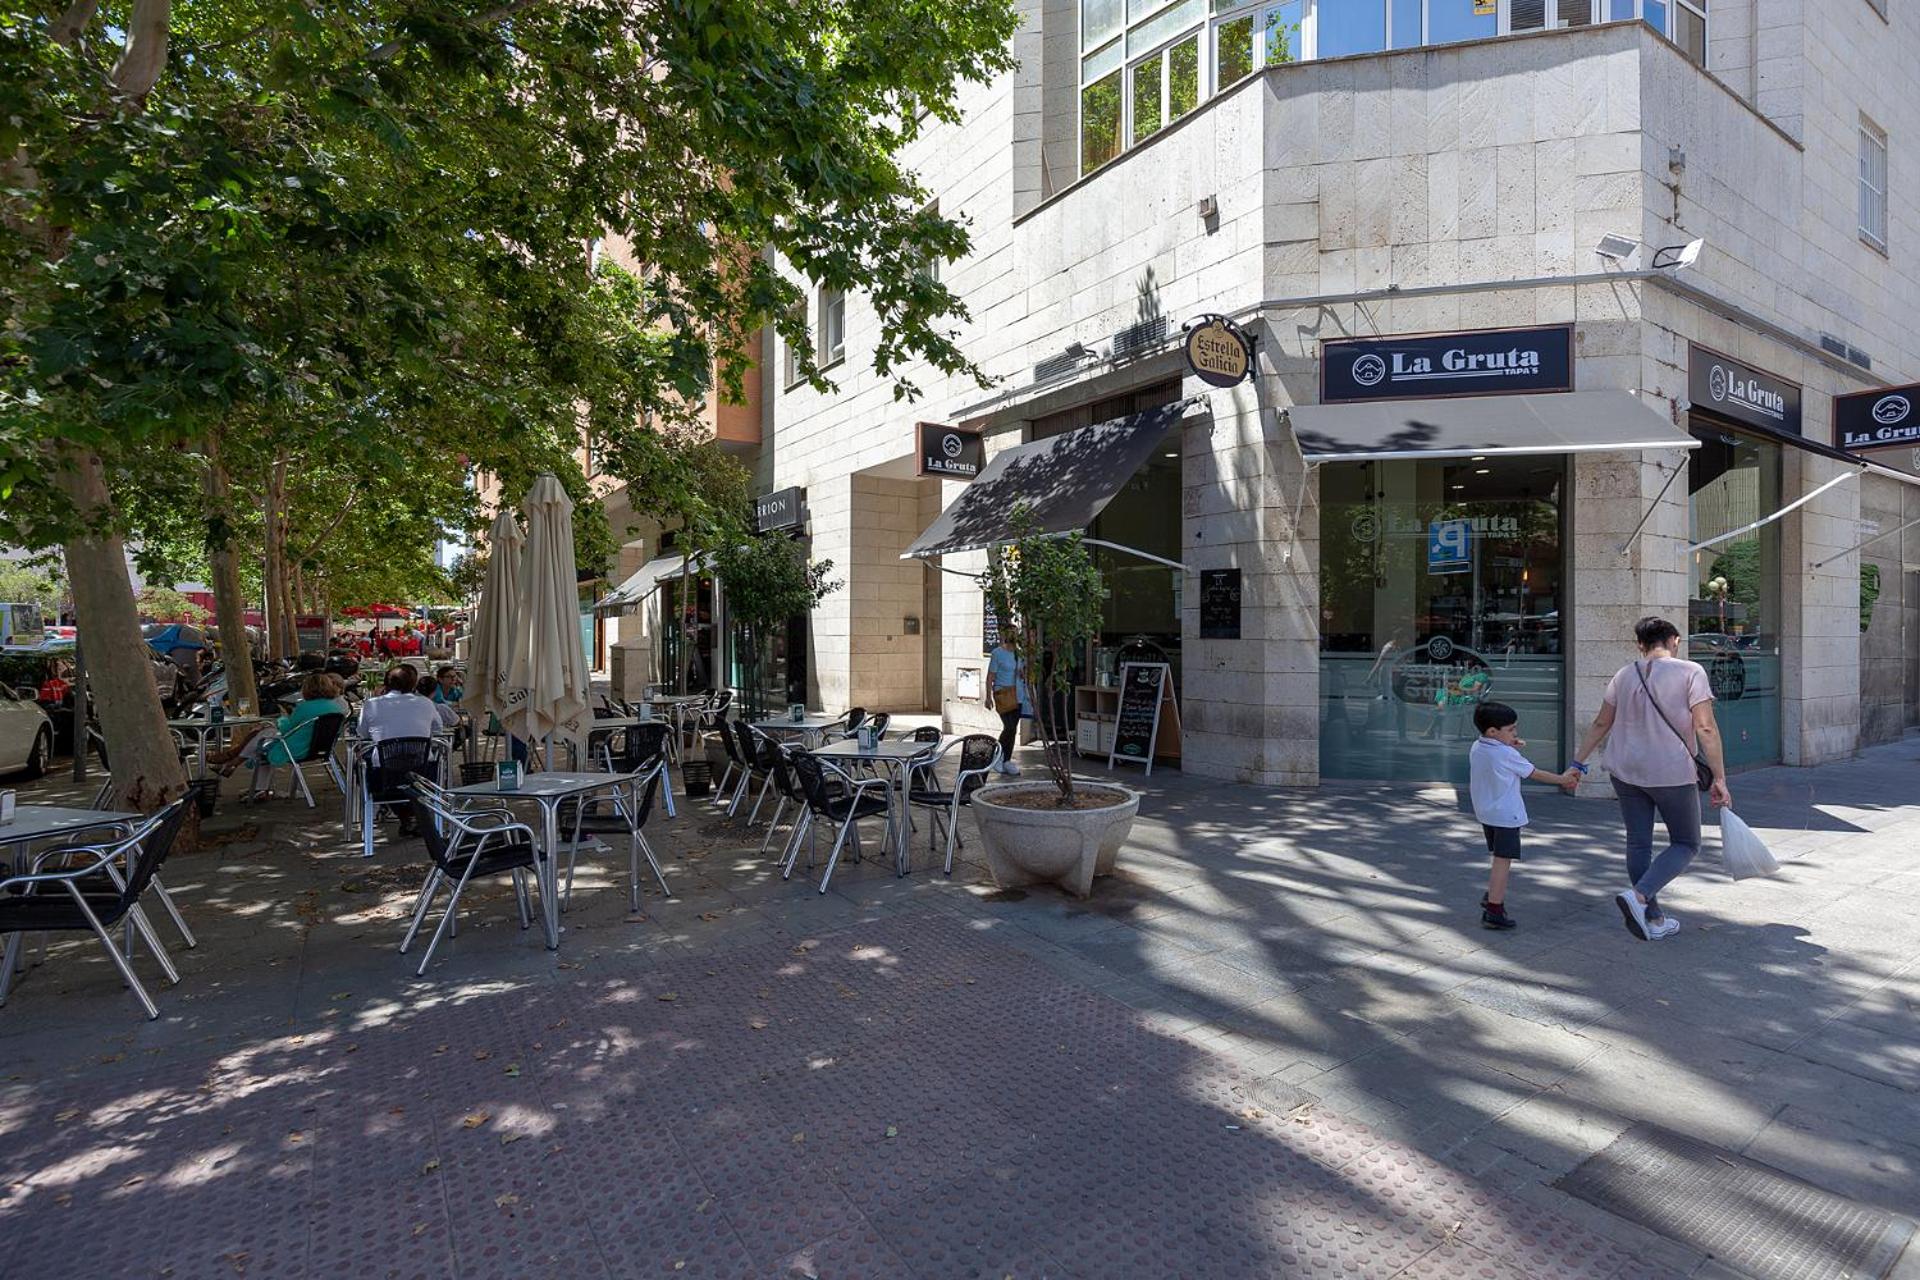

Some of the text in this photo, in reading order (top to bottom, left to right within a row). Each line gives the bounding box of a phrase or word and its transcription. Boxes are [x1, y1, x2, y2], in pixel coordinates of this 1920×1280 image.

[1197, 335, 1240, 358] Estrella
[1200, 351, 1238, 373] Galicia
[1391, 347, 1540, 374] La Gruta
[1728, 370, 1784, 413] La Gruta
[1844, 425, 1920, 444] La Gru
[927, 457, 977, 472] La Gruta
